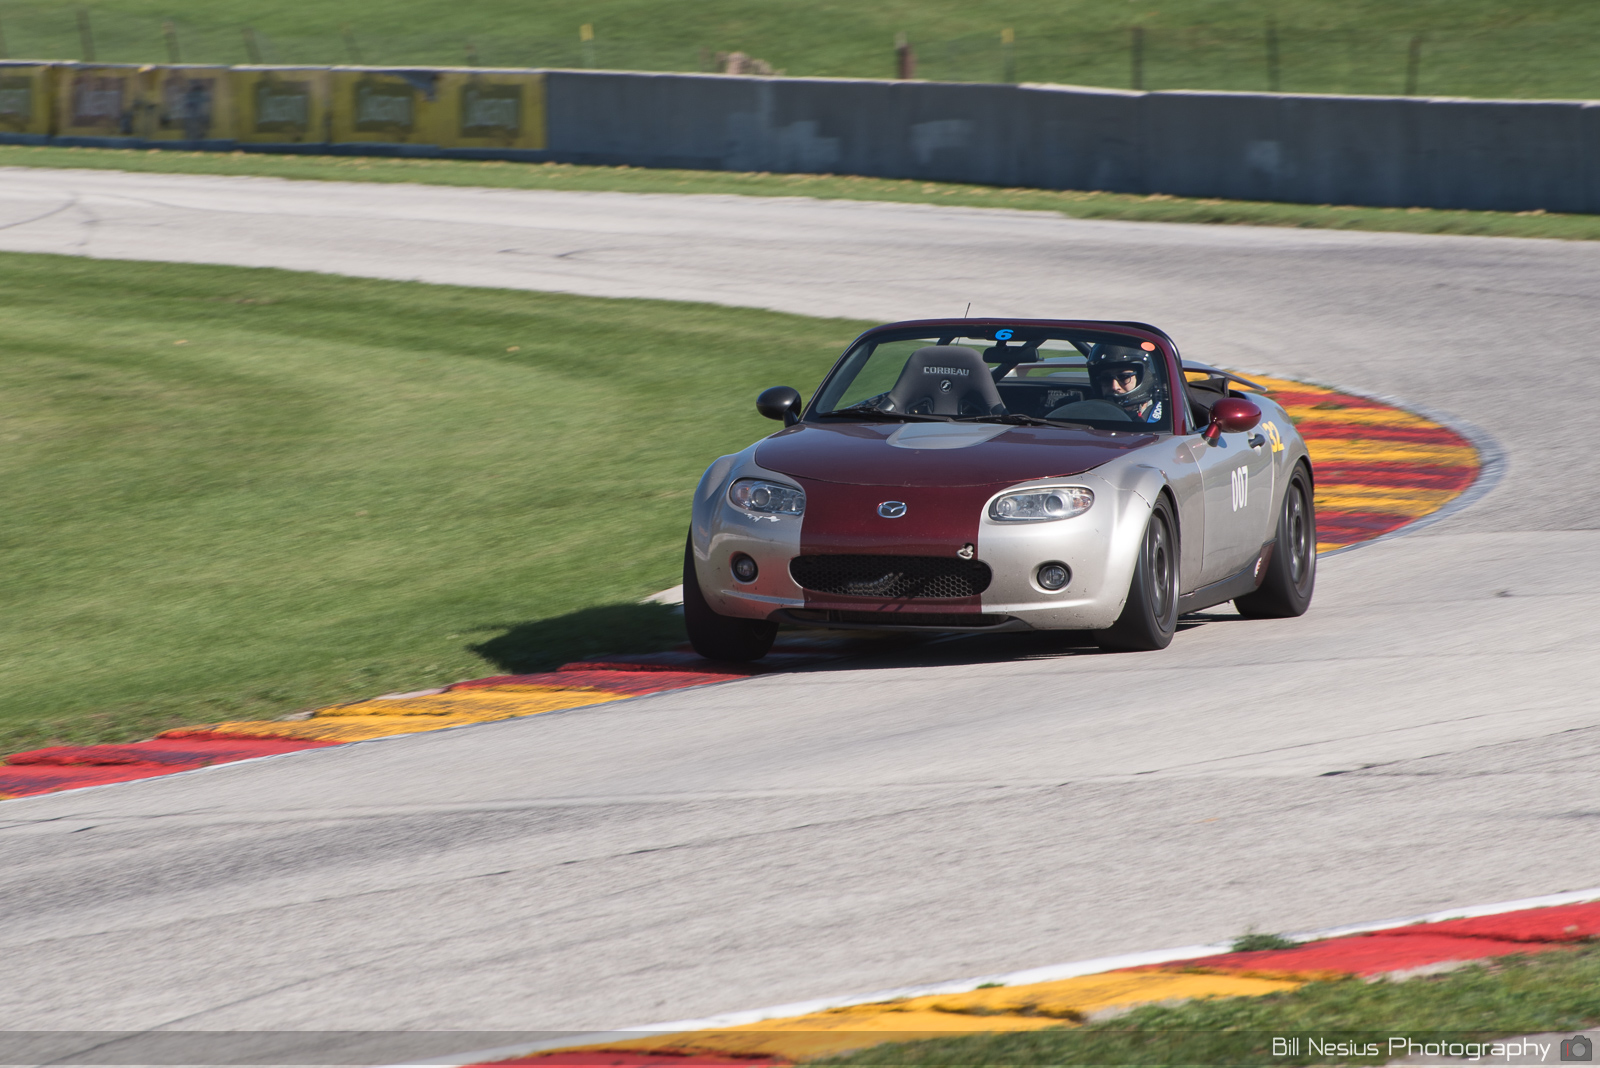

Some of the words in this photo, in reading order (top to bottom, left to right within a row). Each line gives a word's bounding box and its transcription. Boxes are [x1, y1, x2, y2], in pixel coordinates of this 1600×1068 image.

[994, 328, 1014, 341] 6
[923, 366, 970, 376] CORBEAU
[1262, 420, 1285, 453] 32
[1231, 465, 1249, 512] 007
